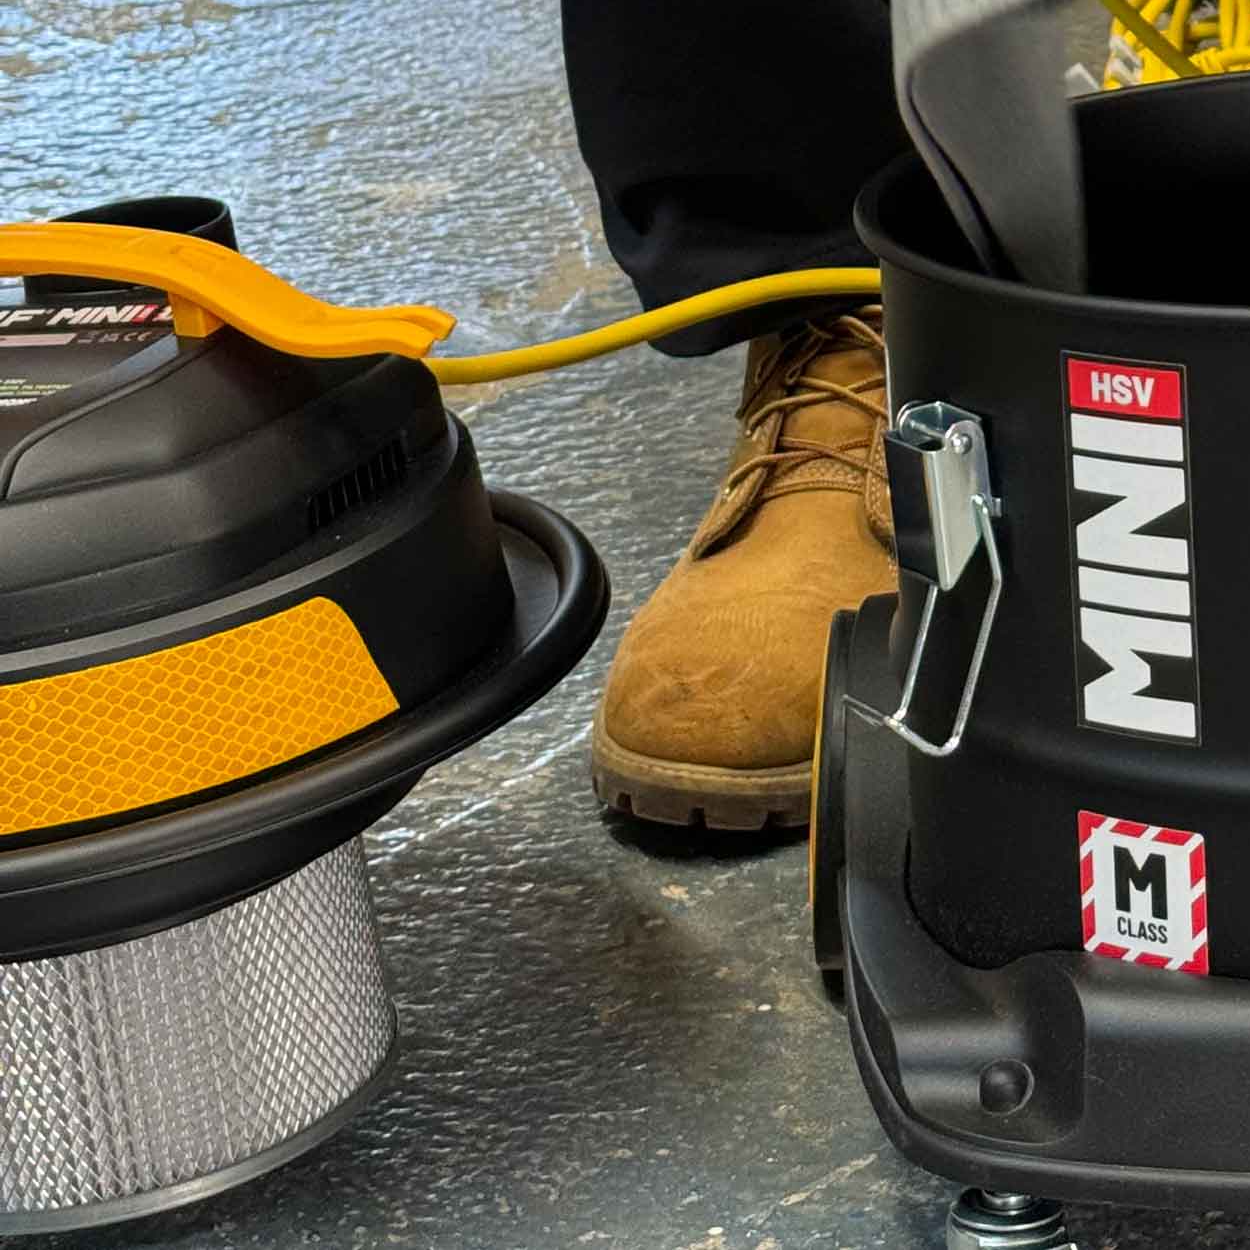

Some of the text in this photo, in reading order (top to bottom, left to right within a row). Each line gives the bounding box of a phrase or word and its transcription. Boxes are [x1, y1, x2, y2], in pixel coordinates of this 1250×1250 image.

[1090, 361, 1155, 407] HSV
[1070, 413, 1197, 739] MINI
[1113, 845, 1169, 920] M
[1116, 916, 1168, 944] CLASS
